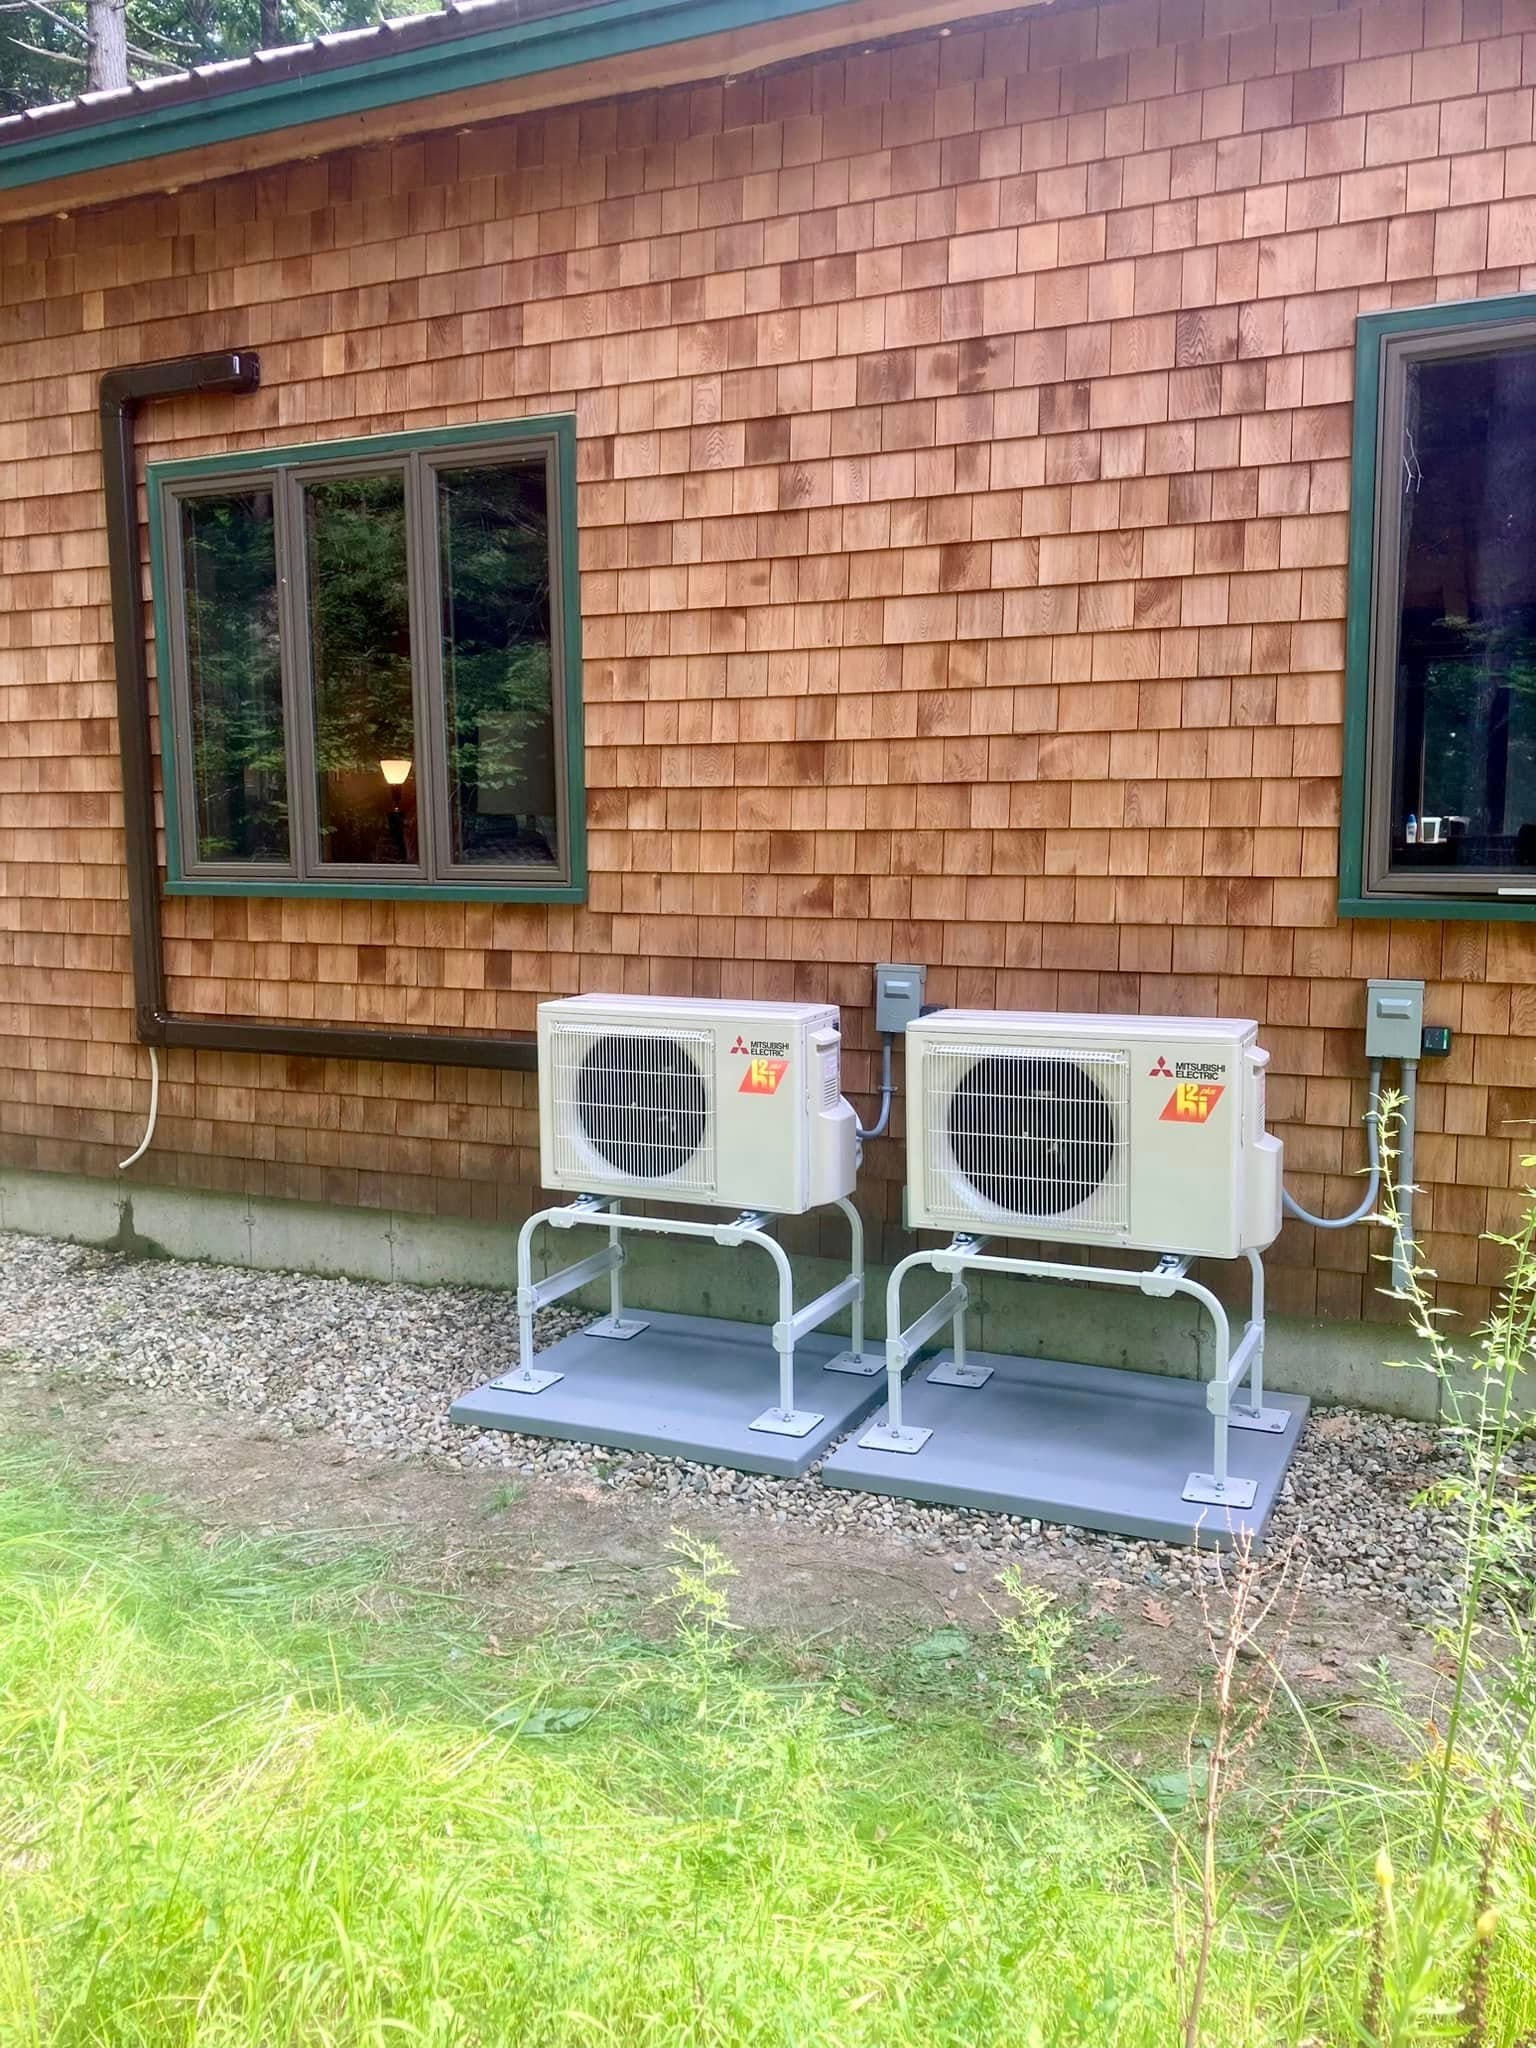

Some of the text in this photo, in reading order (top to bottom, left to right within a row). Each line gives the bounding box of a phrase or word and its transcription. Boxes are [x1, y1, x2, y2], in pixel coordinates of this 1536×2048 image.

[750, 1041, 790, 1050] MITSUBISHI
[750, 1049, 785, 1057] ELECTRIC
[1175, 1062, 1226, 1073] MITSUBISHI
[1175, 1070, 1219, 1081] ELECTRIC
